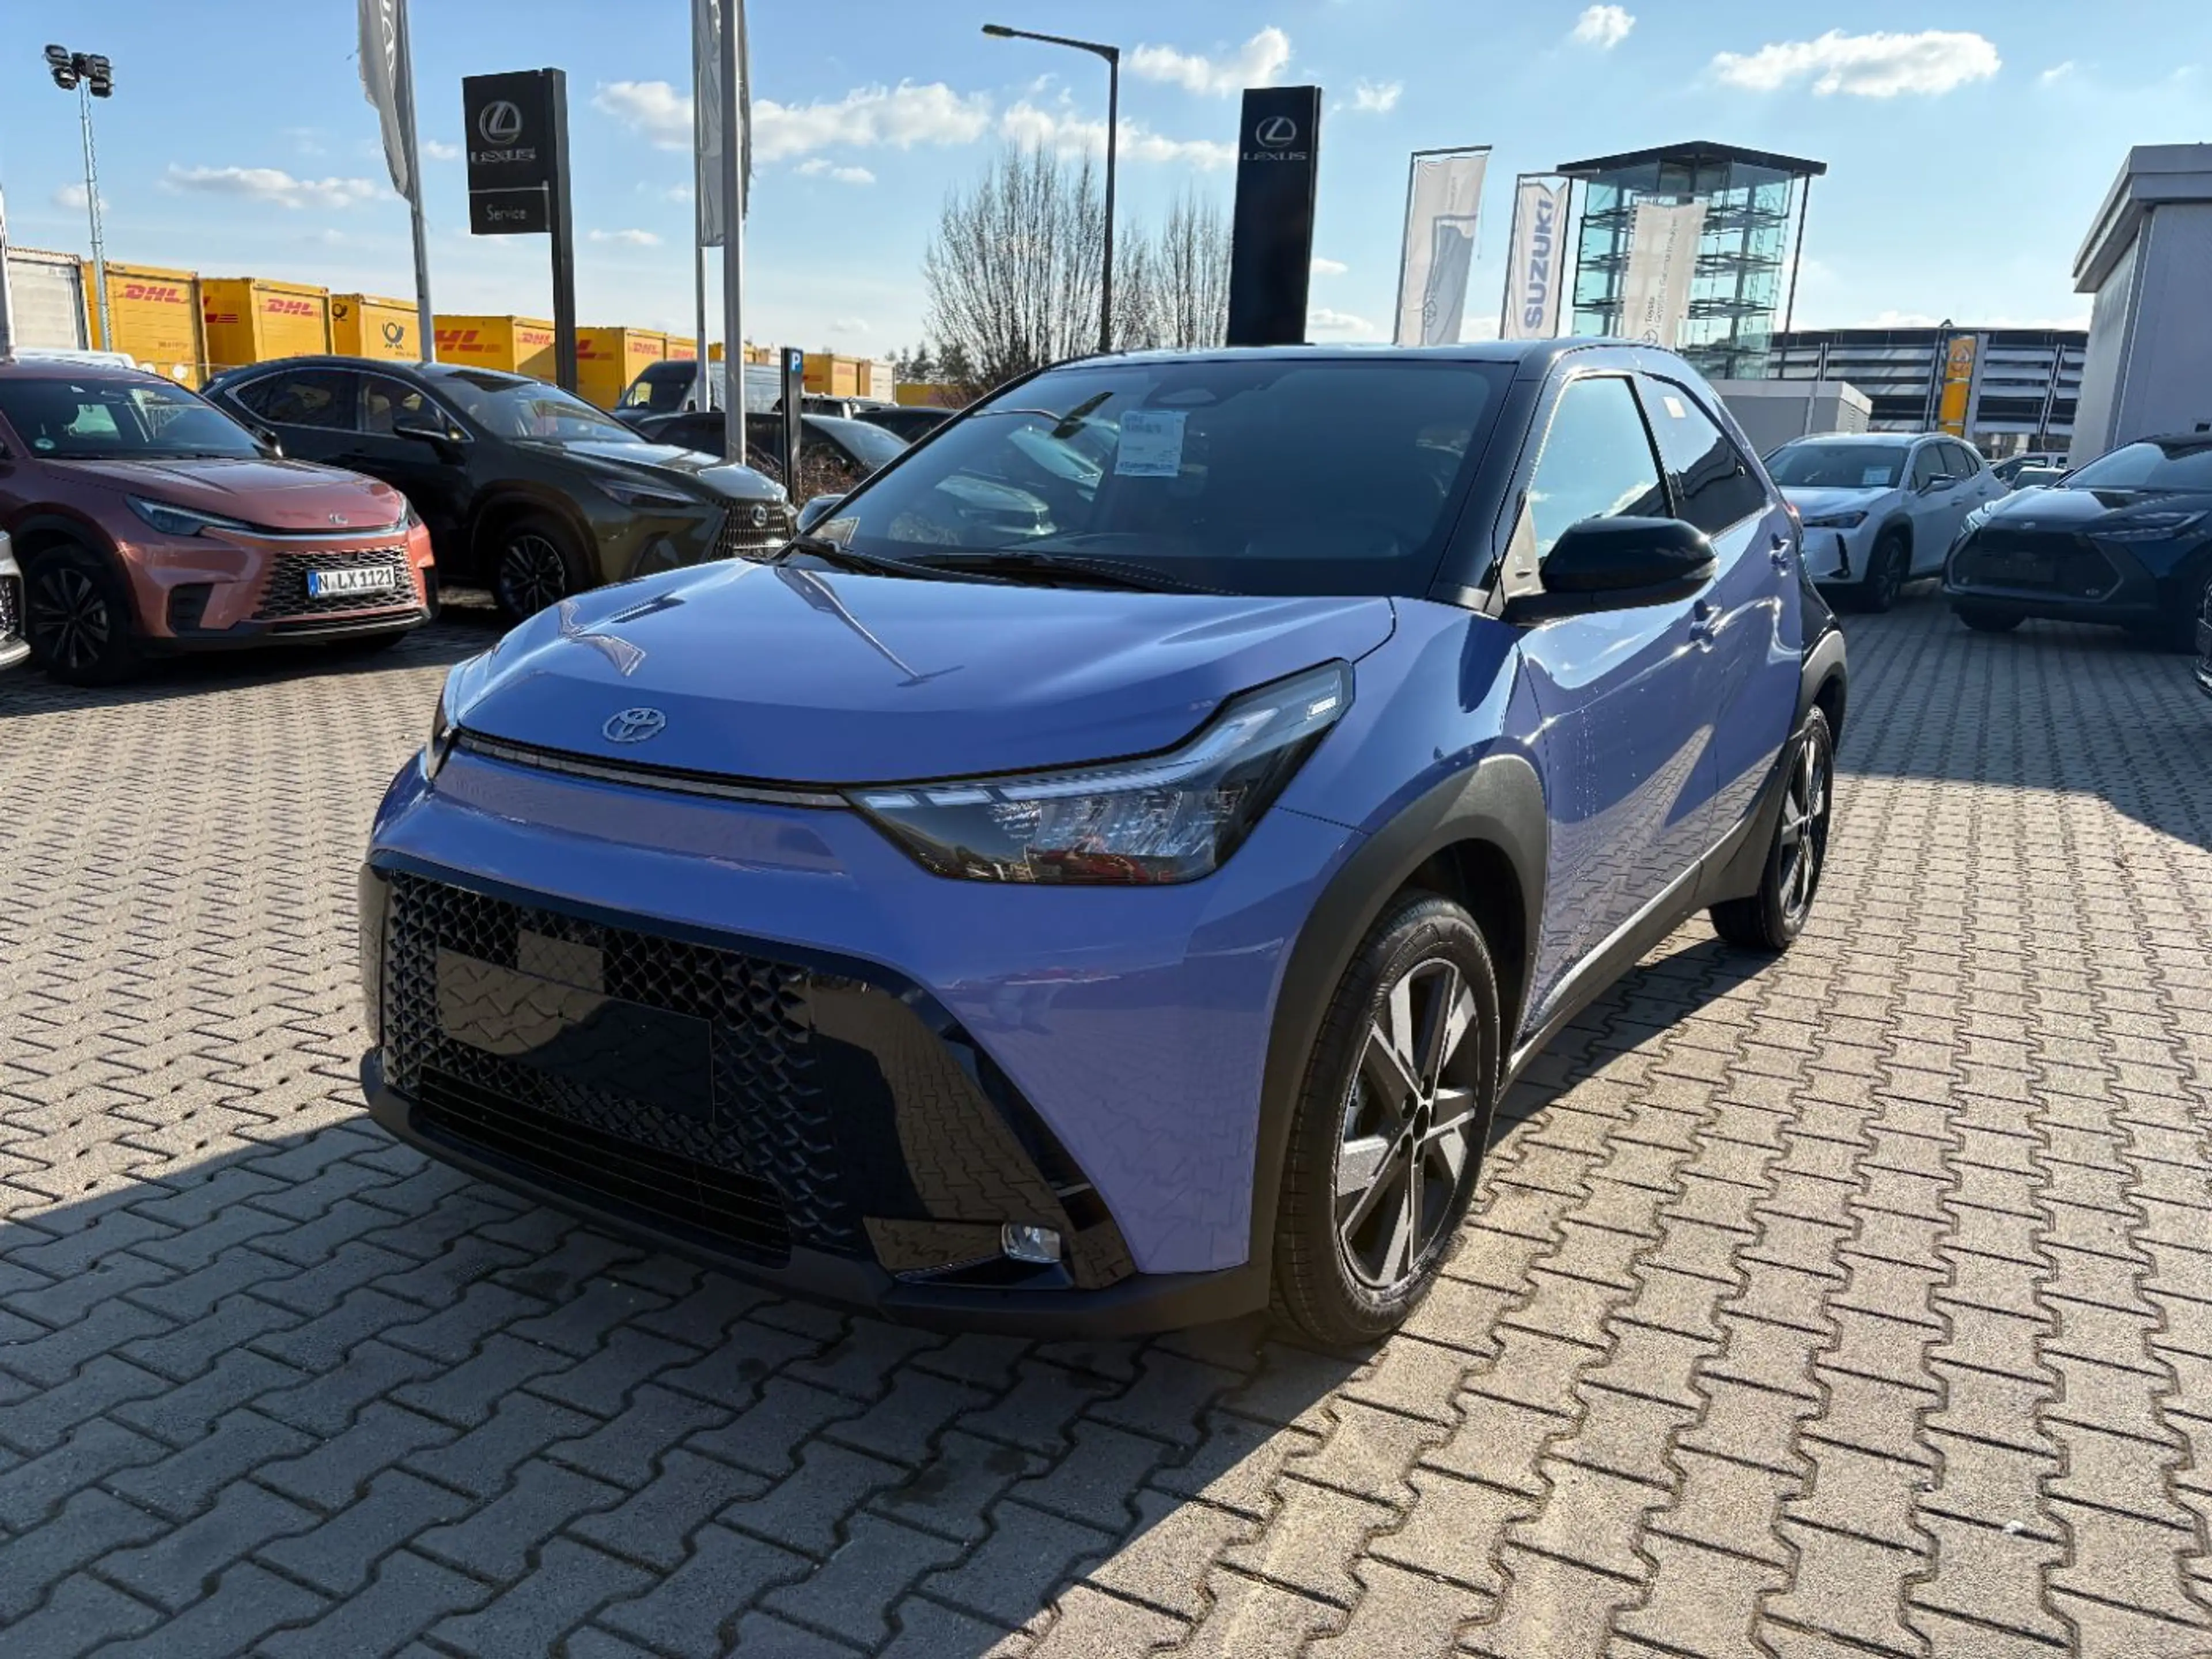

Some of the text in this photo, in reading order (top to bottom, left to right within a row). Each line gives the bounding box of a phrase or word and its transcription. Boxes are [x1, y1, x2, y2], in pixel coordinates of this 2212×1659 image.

[1243, 151, 1307, 161] LEXUS
[486, 204, 527, 221] Service
[1525, 199, 1554, 329] SUZUKI
[125, 284, 180, 303] DHL
[266, 298, 313, 316] DHL
[435, 330, 485, 351] HL
[791, 353, 801, 371] P
[318, 569, 393, 590] N LX 1121
